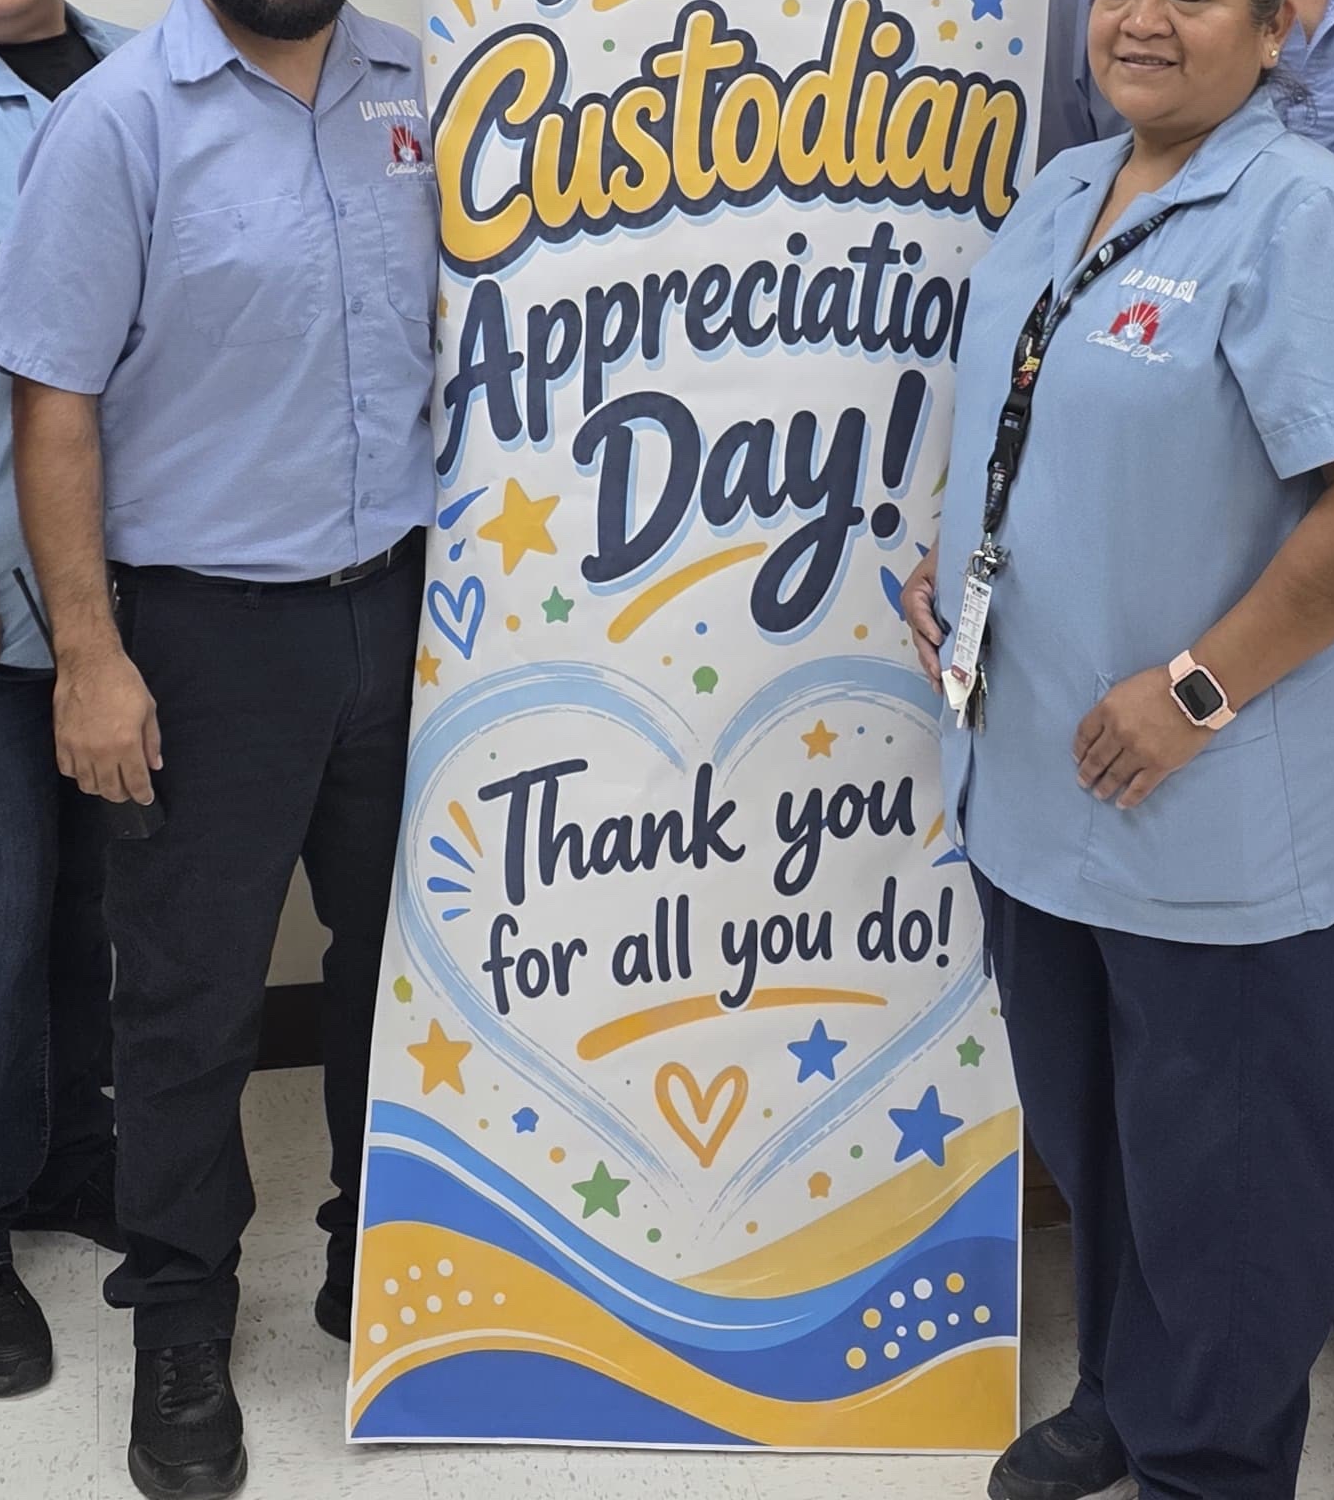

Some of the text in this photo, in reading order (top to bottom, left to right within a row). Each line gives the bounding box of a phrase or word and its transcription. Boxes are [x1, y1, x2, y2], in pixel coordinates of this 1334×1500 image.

[359, 100, 376, 121] LA
[375, 100, 401, 118] JOYA
[1119, 268, 1198, 303] LA JOYA ISD
[1086, 330, 1135, 352] Custodial
[572, 369, 926, 635] Day!
[477, 758, 916, 906] Thank you
[482, 876, 954, 1015] for all you do!
